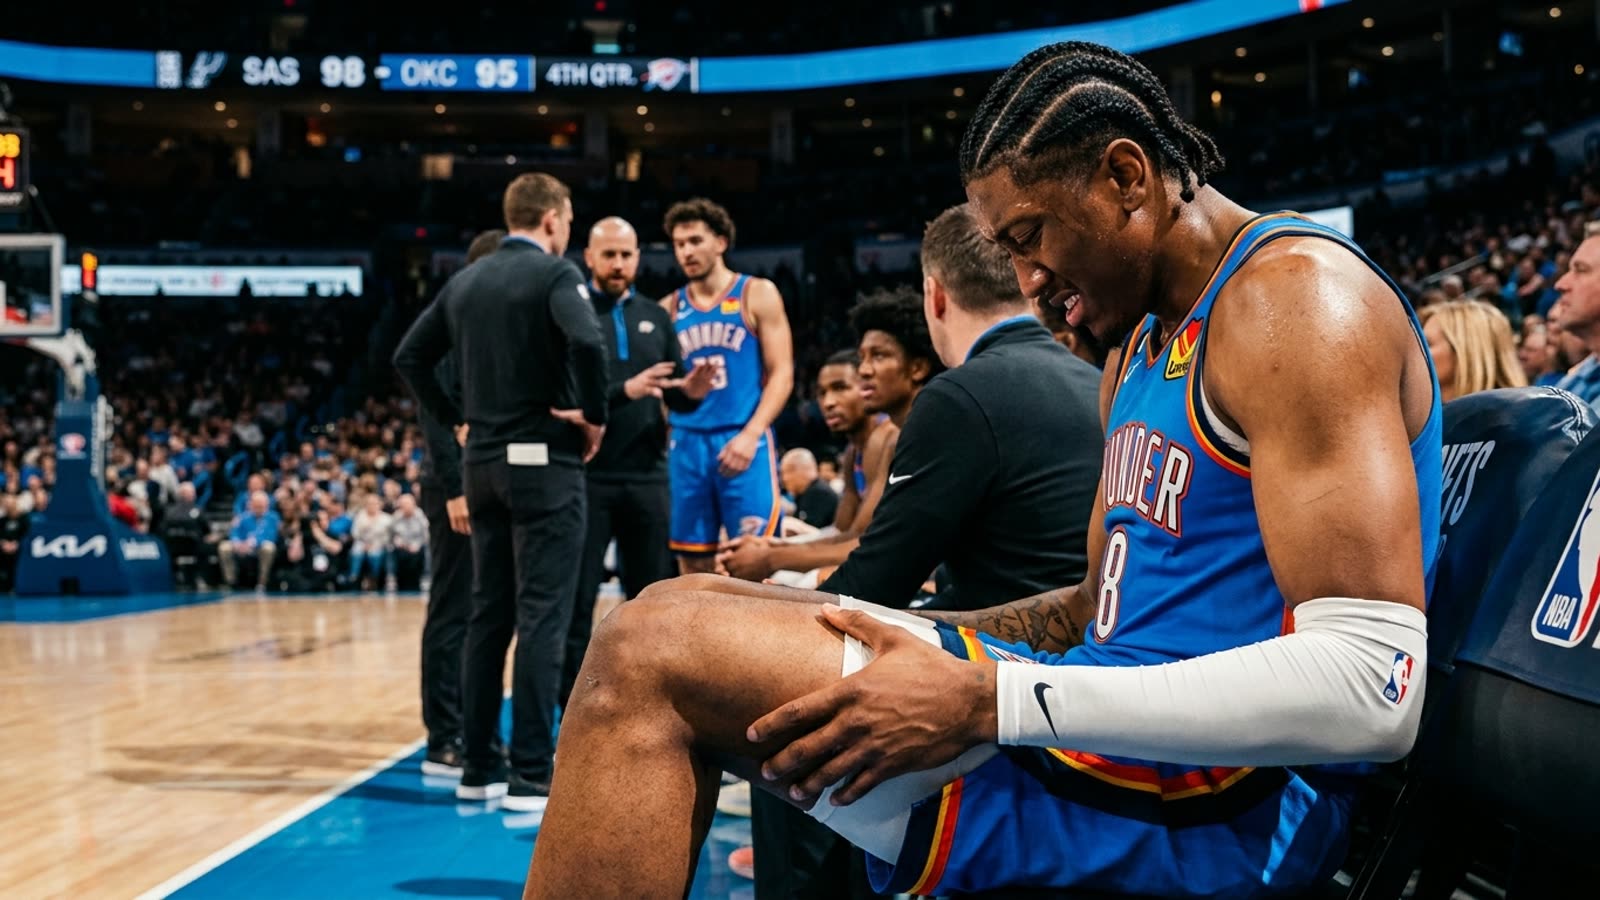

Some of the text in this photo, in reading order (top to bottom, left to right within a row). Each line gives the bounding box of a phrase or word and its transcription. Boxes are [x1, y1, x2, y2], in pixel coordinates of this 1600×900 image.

[242, 56, 300, 86] SAS
[320, 55, 366, 88] 98
[400, 58, 459, 87] OKC
[475, 58, 519, 88] 95
[545, 63, 587, 86] 4TH
[1103, 422, 1194, 538] UNDER
[1095, 526, 1127, 643] 8
[1542, 593, 1578, 630] NBA
